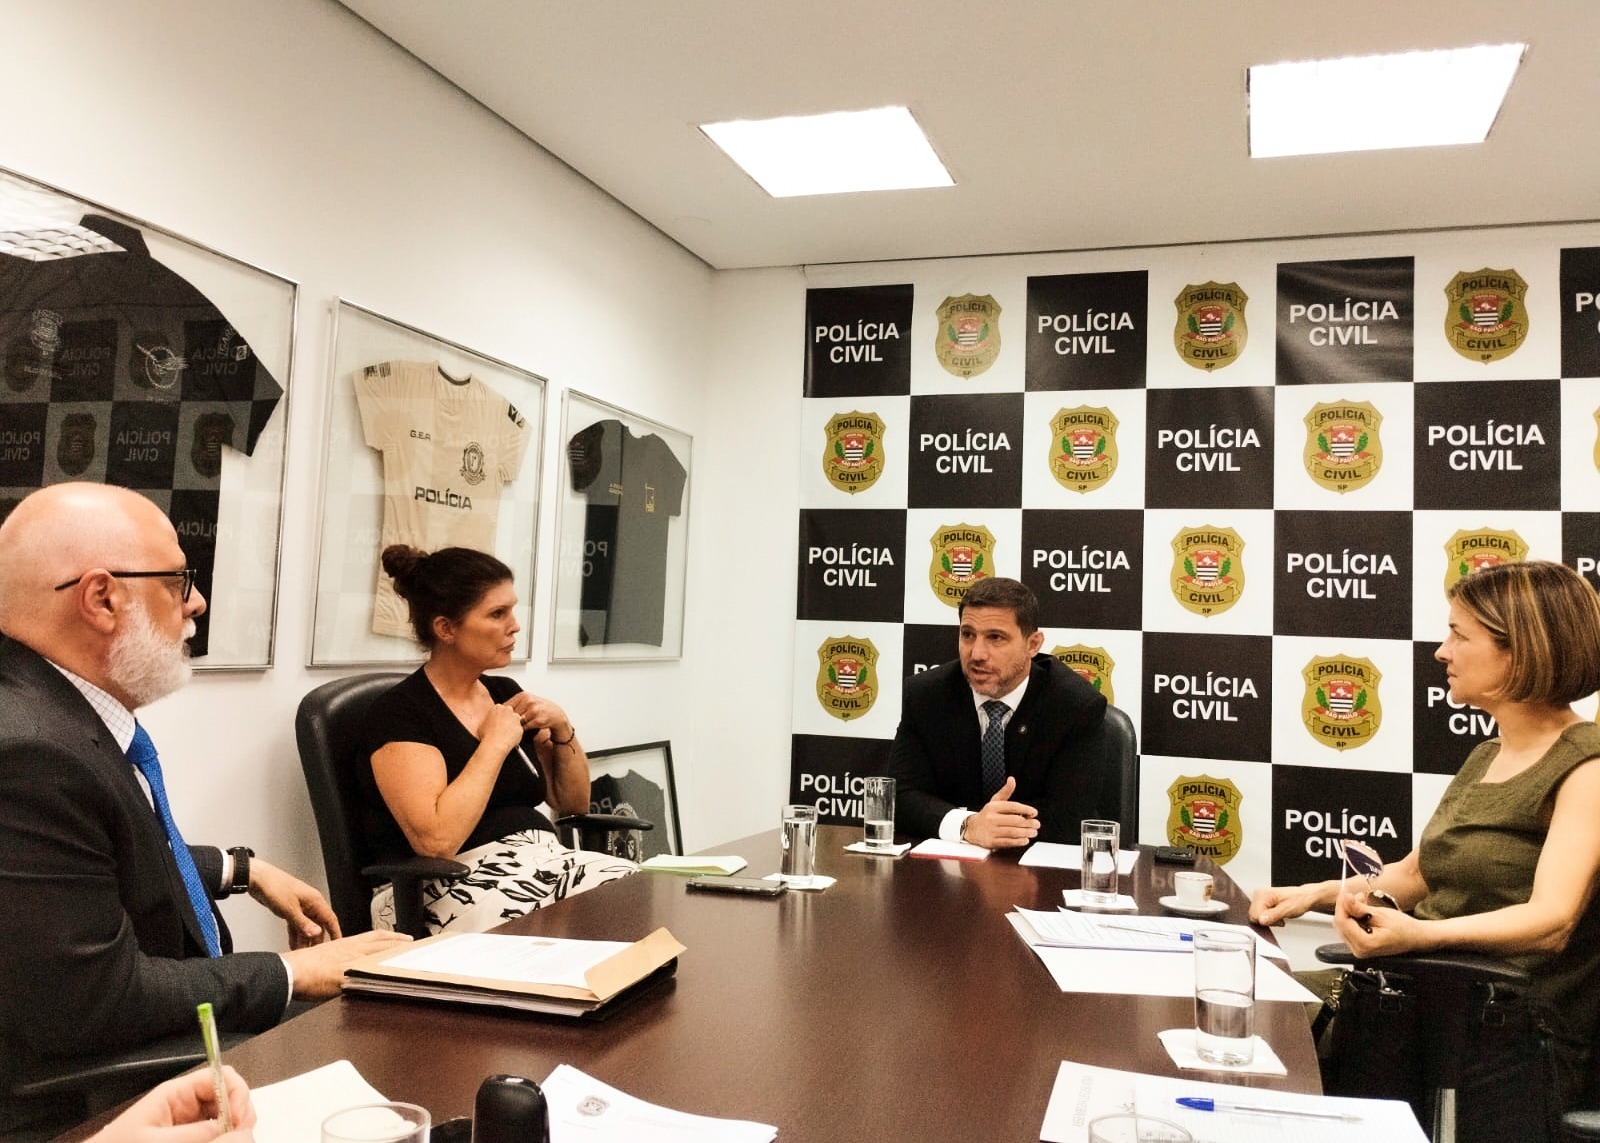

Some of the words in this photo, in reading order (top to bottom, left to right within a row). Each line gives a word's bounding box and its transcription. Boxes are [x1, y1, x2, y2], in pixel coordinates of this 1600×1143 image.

[1462, 276, 1510, 290] POLÍCIA
[1190, 288, 1232, 301] POLÍCIA
[1289, 297, 1399, 323] POLÍCIA
[1038, 309, 1134, 333] POLÍCIA
[815, 319, 899, 342] POLÍCIA
[1308, 326, 1378, 346] CIVIL
[1055, 335, 1115, 354] CIVIL
[1467, 339, 1505, 349] CIVIL
[830, 345, 882, 363] CIVIL
[1193, 349, 1227, 358] CIVIL
[837, 418, 872, 430] POLÍCIA
[1063, 414, 1104, 426] POLÍCIA
[1320, 409, 1366, 421] POLÍCIA
[921, 429, 1011, 451] POLÍCIA
[1159, 424, 1260, 448] POLÍCIA
[1429, 420, 1545, 445] POLÍCIA
[936, 455, 992, 473] CIVIL
[1176, 453, 1240, 471] CIVIL
[1449, 450, 1522, 470] CIVIL
[838, 472, 867, 481] CIVIL
[1066, 471, 1099, 480] CIVIL
[1324, 470, 1361, 480] CIVIL
[415, 486, 472, 510] POLÍCIA
[944, 532, 981, 543] POLÍCIA
[1186, 533, 1229, 546] POLÍCIA
[1462, 536, 1510, 550] POLÍCIA
[809, 543, 894, 565] POLÍCIA
[1034, 545, 1130, 569] POLÍCIA
[1288, 549, 1398, 574] POLÍCIA
[824, 569, 876, 586] CIVIL
[1050, 573, 1111, 592] CIVIL
[946, 587, 969, 597] CIV
[1307, 578, 1376, 599] CIVIL
[1190, 593, 1225, 603] CIVIL
[830, 643, 866, 656] POLÍCIA
[1318, 662, 1365, 677] POLÍCIA
[1155, 672, 1258, 698] POLÍCIA
[832, 699, 861, 708] CIVIL
[1173, 699, 1237, 721] CIVIL
[1322, 725, 1360, 736] CIVIL
[1449, 713, 1501, 736] CIV
[1183, 783, 1226, 798] POLÍCIA
[1286, 808, 1397, 838] POLÍCIA
